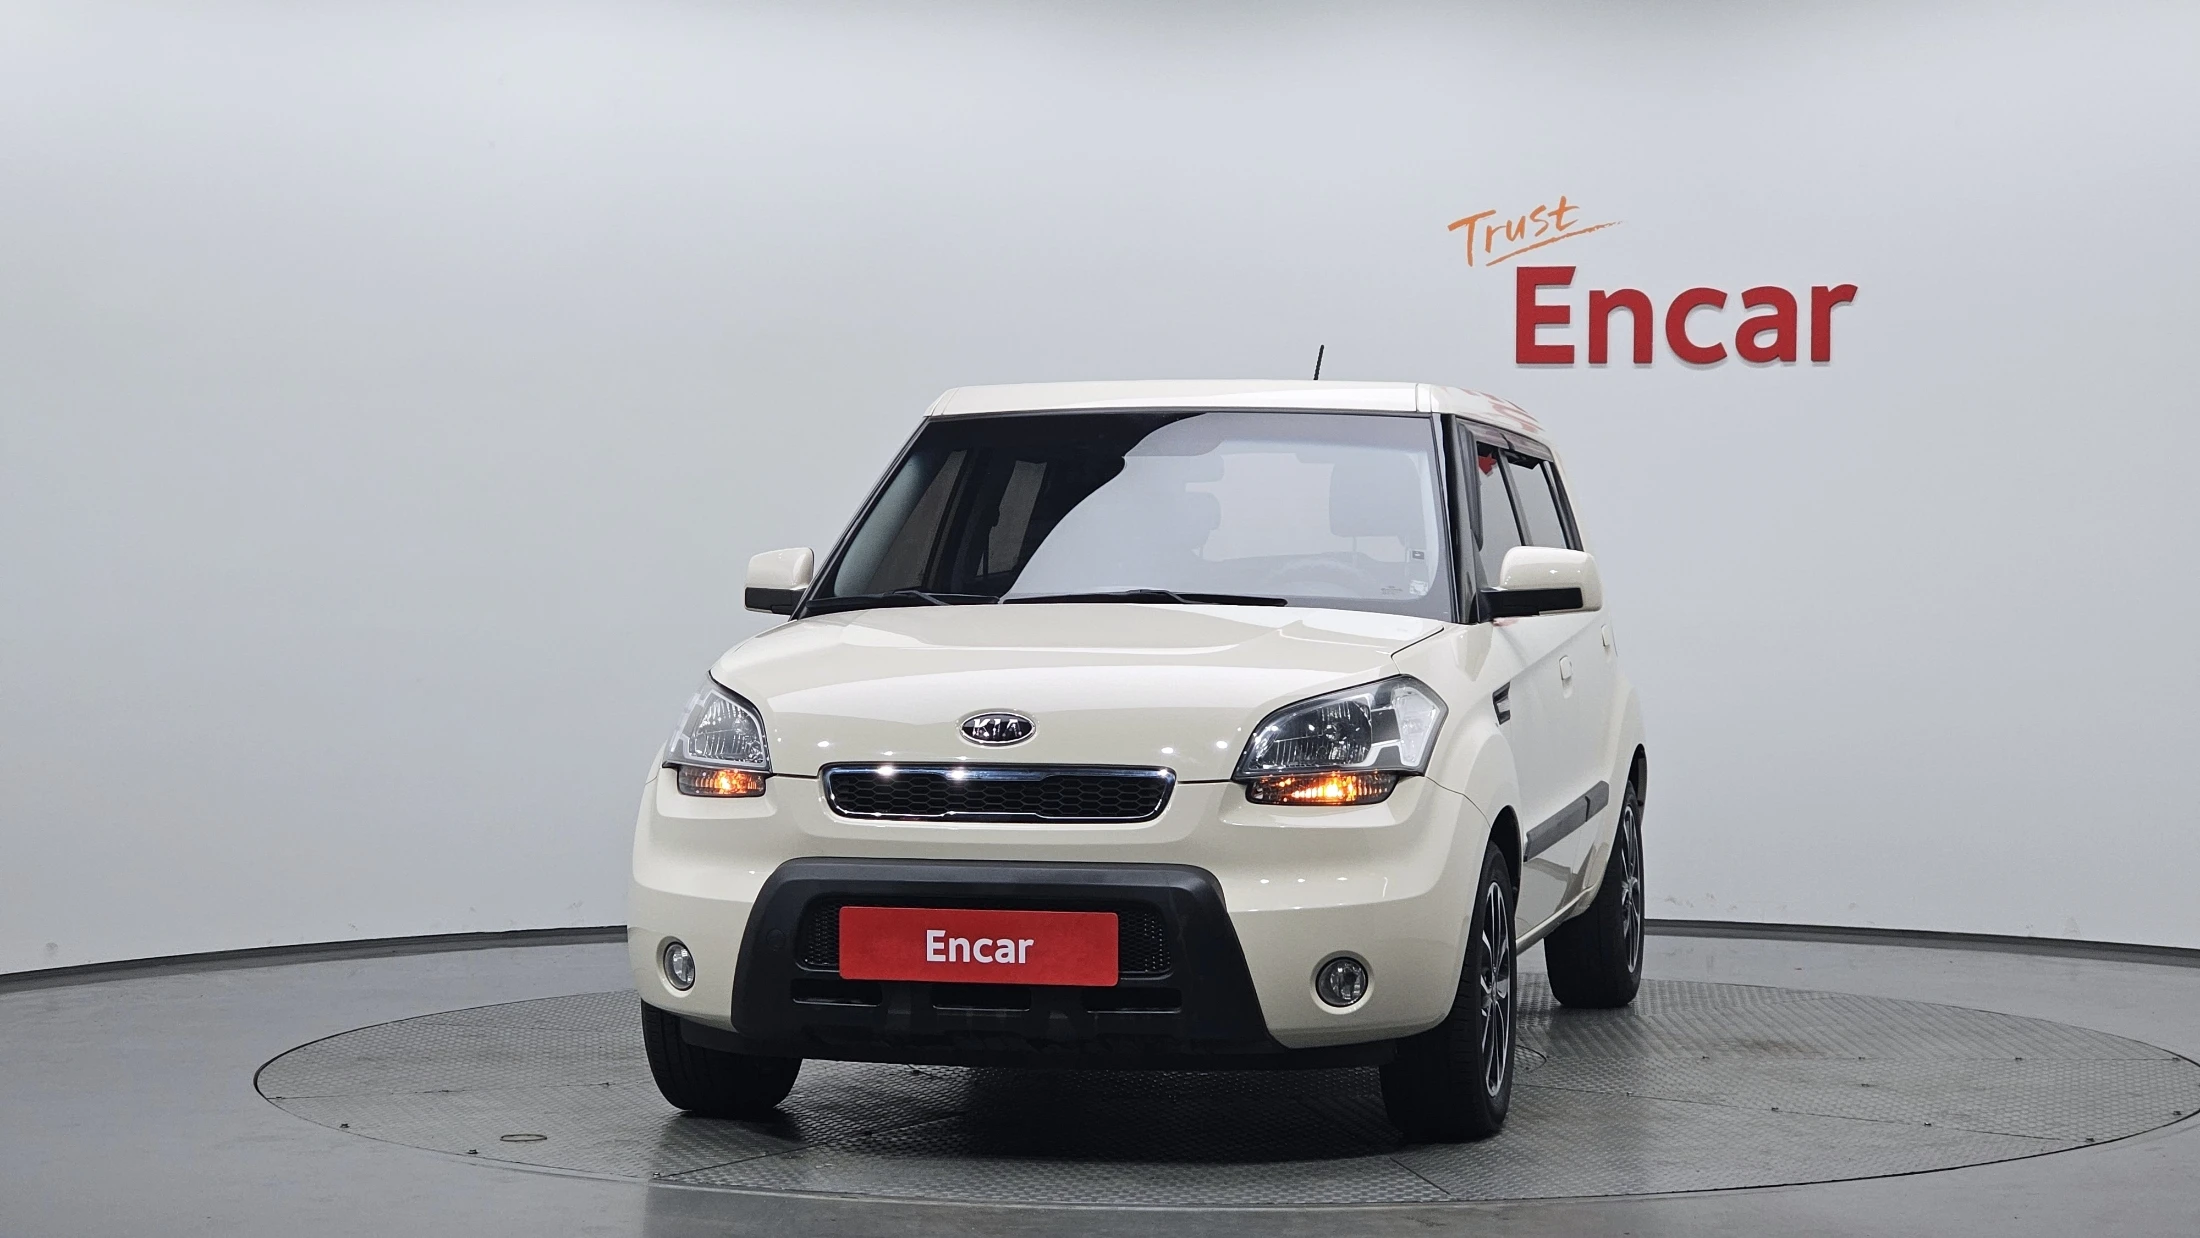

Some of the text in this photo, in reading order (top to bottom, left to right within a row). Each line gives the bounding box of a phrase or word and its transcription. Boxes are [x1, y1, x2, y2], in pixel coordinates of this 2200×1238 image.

[1448, 196, 1580, 267] Trust
[1516, 265, 1858, 364] Encar
[972, 718, 1022, 738] KIA
[925, 929, 1034, 964] Encar
